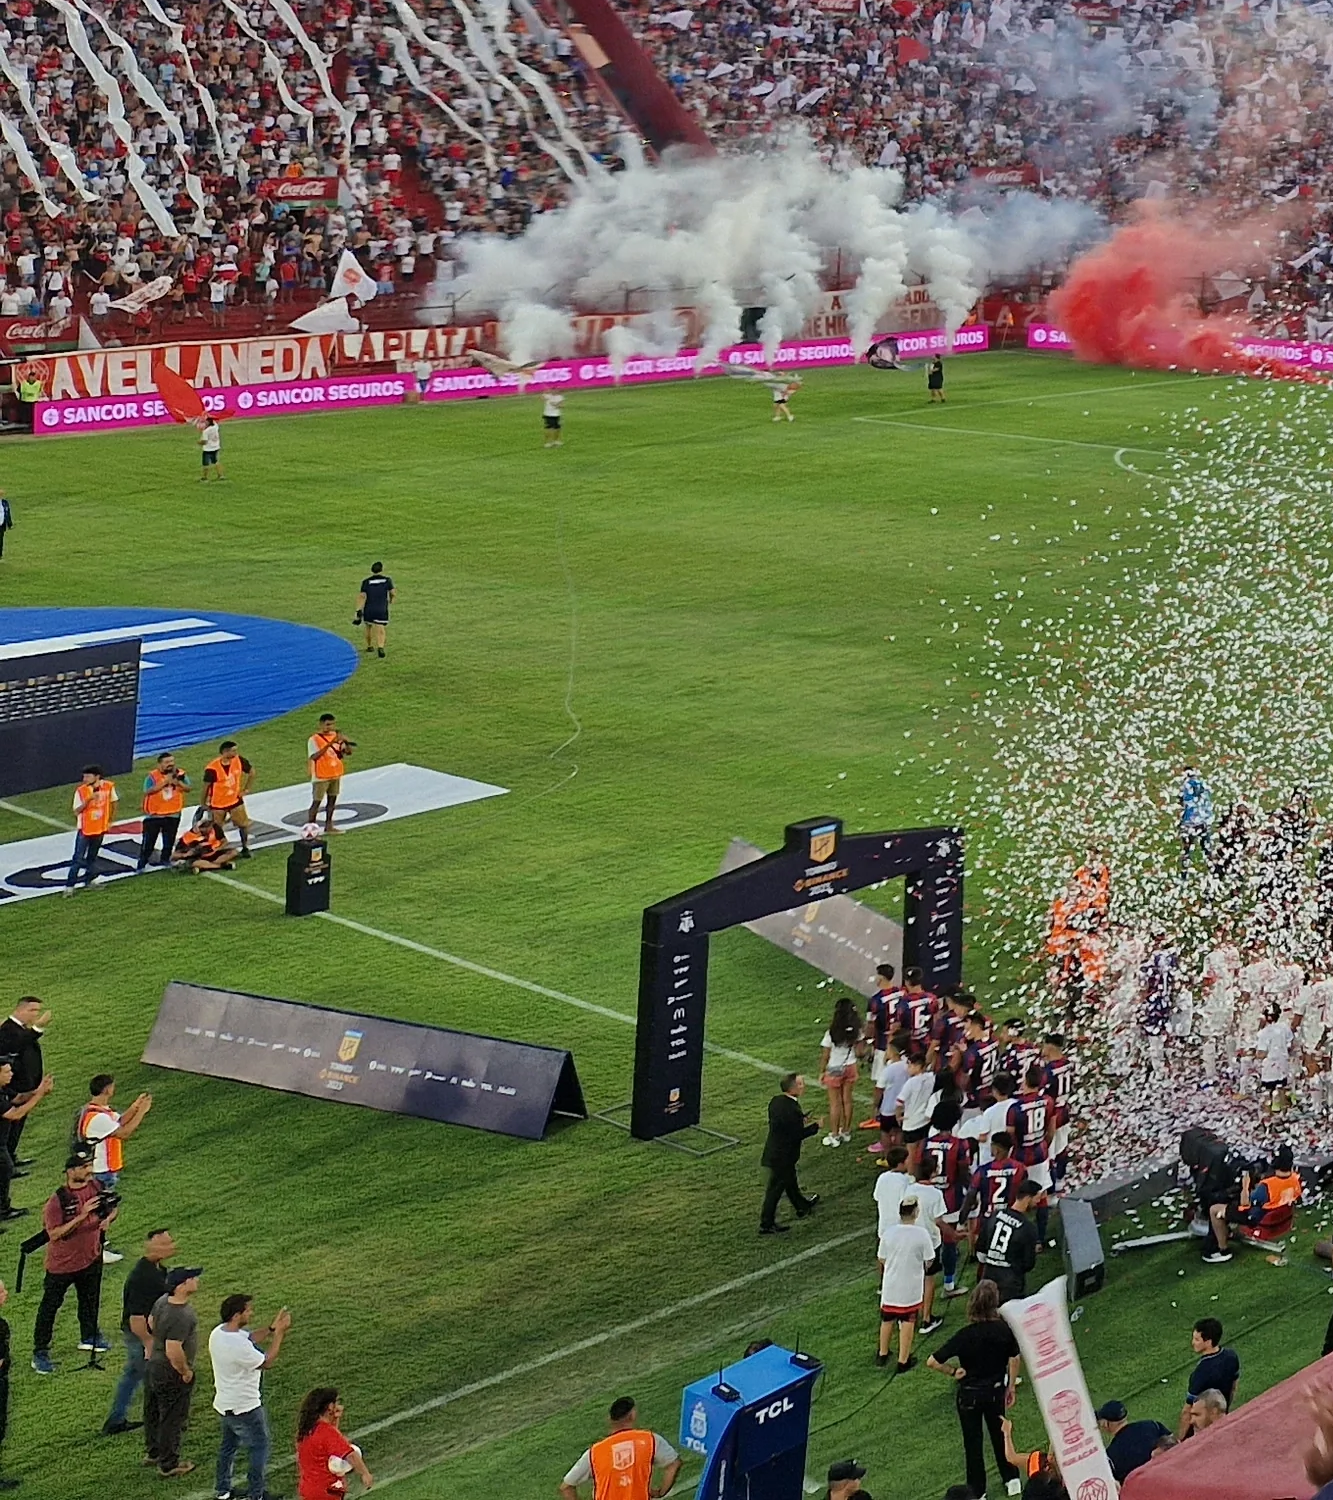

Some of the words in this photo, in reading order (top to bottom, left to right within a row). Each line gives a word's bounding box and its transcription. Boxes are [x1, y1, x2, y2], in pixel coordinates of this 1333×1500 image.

[52, 336, 327, 400] AVELLANEDA
[256, 386, 326, 408] SANCOR
[328, 379, 405, 402] SEGUROS
[63, 403, 137, 425] SANCOR
[142, 394, 226, 417] SEOS
[1026, 1107, 1047, 1135] 18
[992, 1177, 1008, 1204] 2
[989, 1220, 1012, 1254] 13
[755, 1397, 794, 1425] TCL
[685, 1436, 708, 1454] TCL
